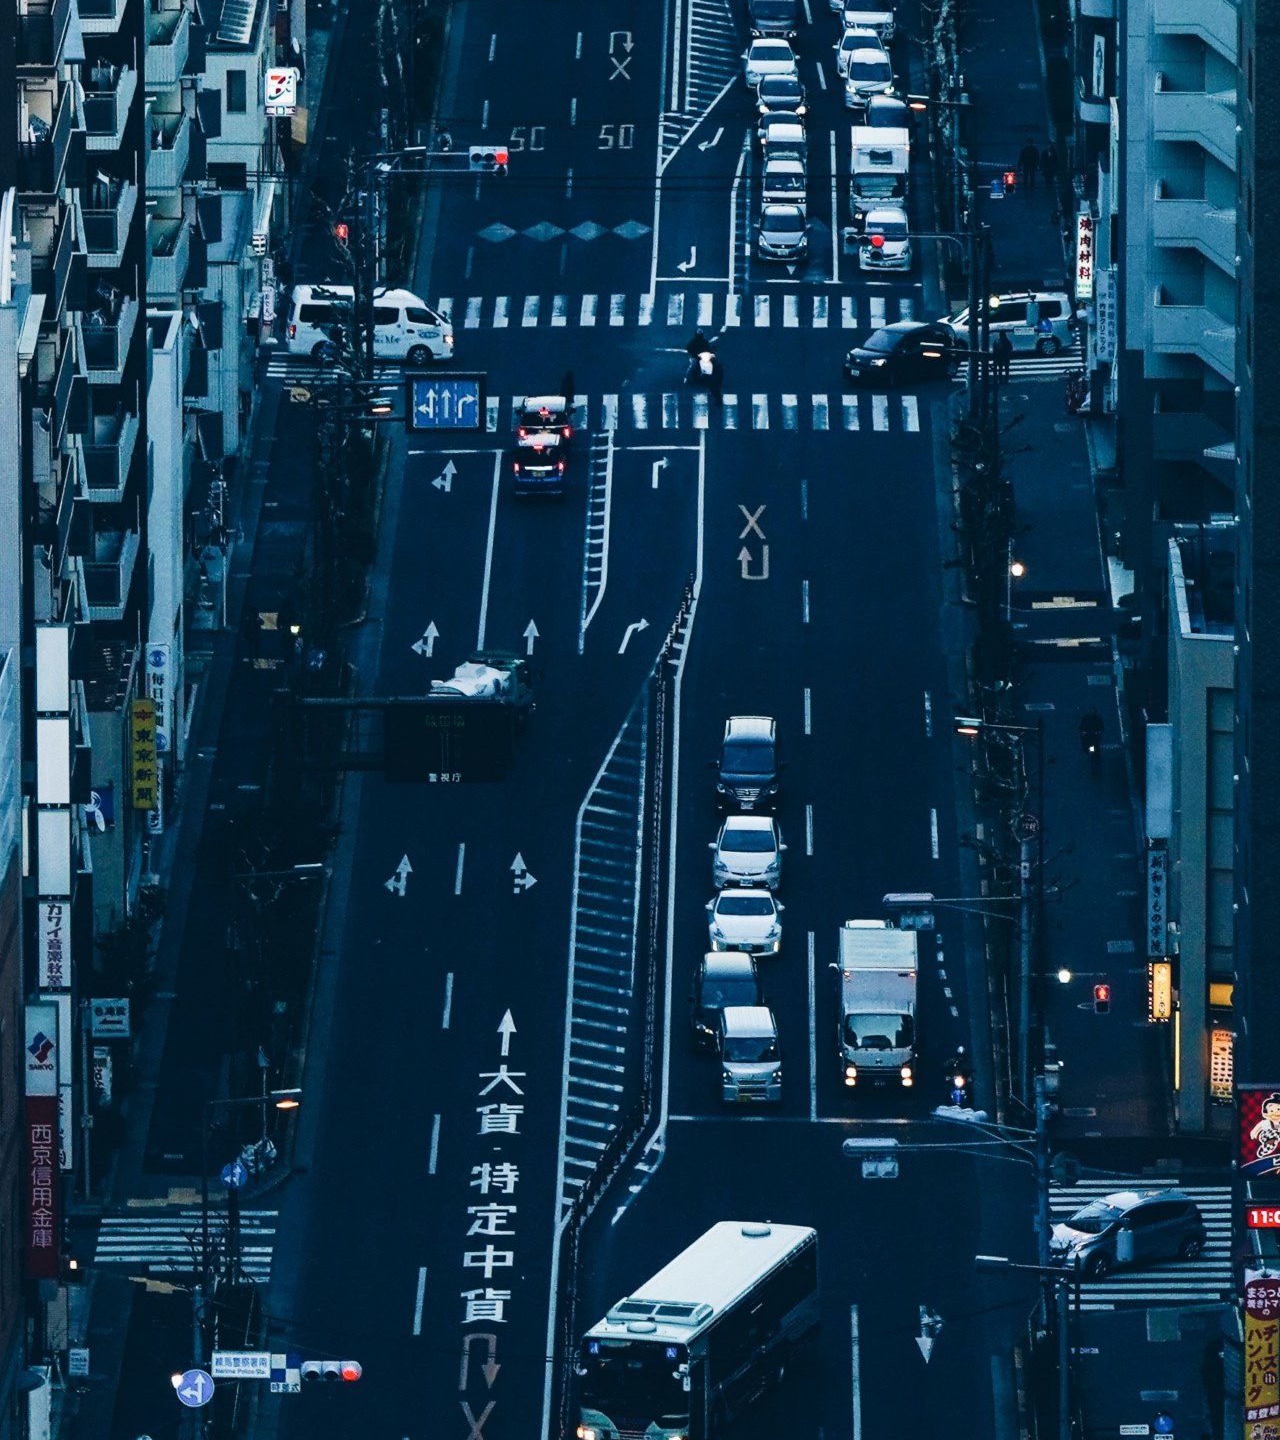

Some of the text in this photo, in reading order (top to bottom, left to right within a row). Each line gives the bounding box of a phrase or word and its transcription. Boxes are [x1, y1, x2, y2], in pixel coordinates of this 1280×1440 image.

[509, 126, 546, 152] 50
[598, 124, 635, 150] 50
[134, 729, 154, 802] 東京新聞
[428, 773, 462, 783] 警視庁
[46, 904, 63, 987] カワイ音楽教室
[29, 1063, 54, 1071] SAIKYO
[31, 1125, 53, 1249] 西京信用金庫
[1247, 1328, 1263, 1403] ハンバーグ
